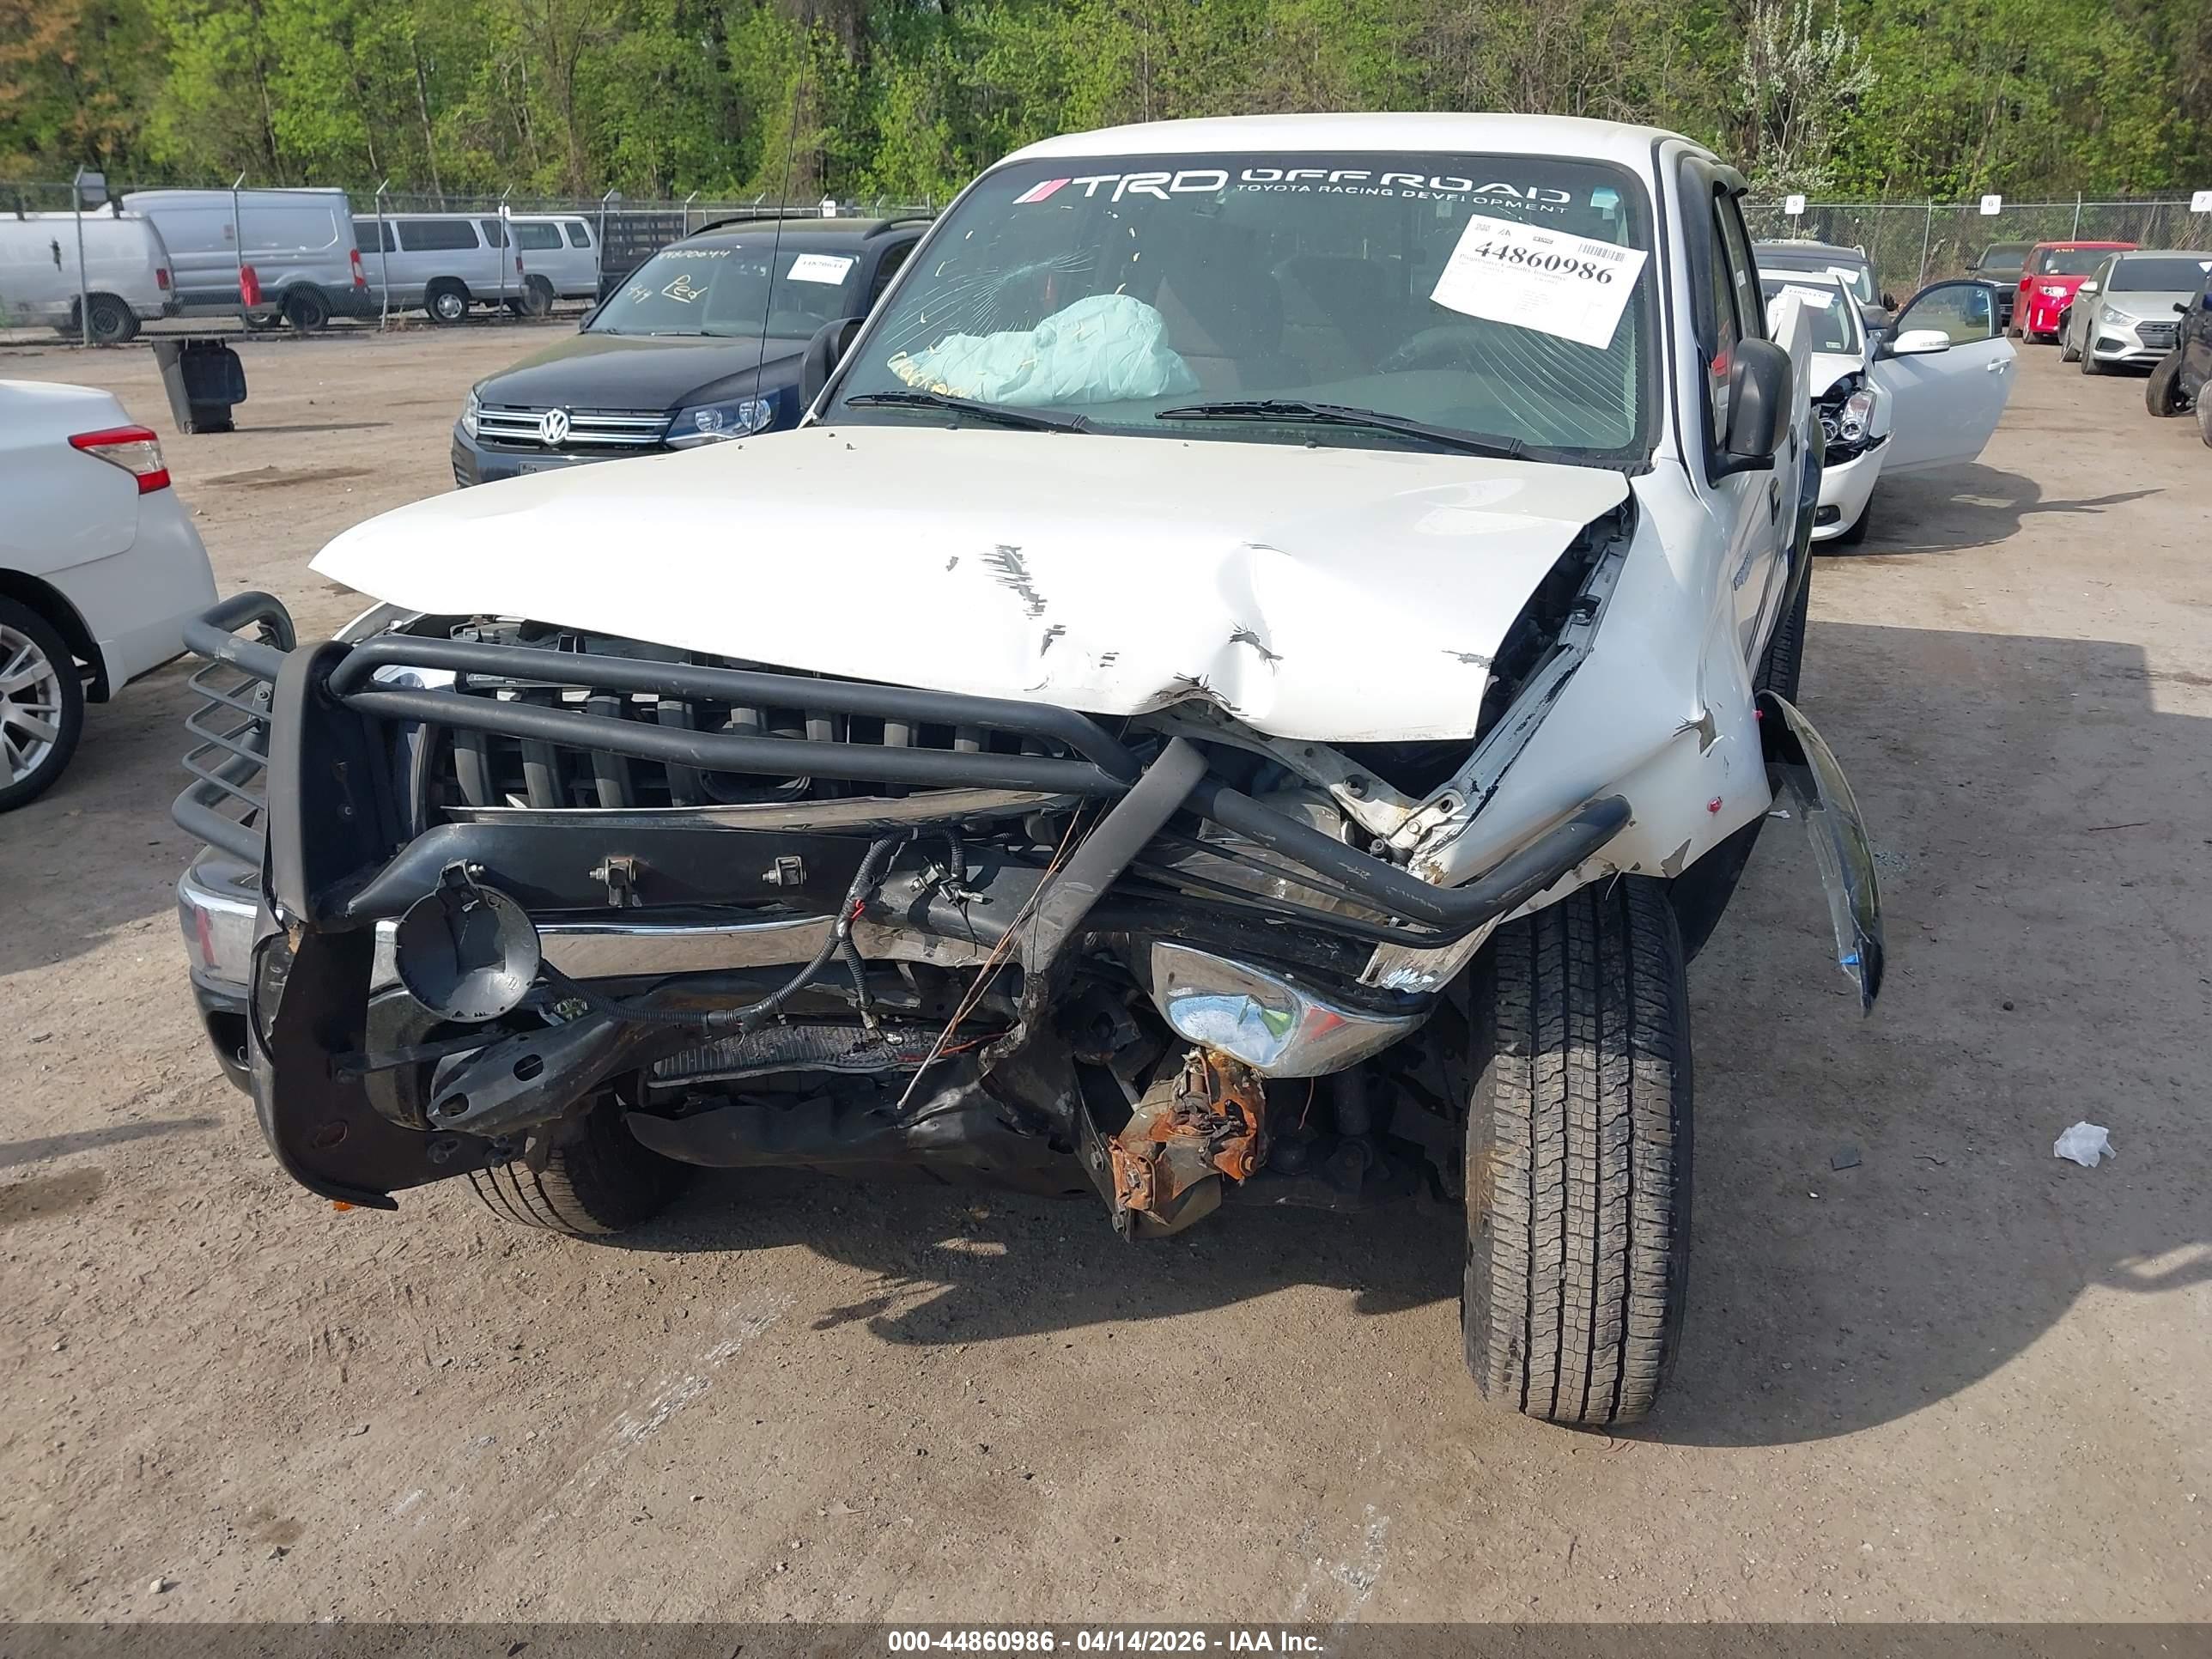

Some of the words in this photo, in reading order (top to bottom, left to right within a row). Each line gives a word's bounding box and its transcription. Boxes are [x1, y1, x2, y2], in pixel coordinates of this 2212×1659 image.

[1072, 169, 1230, 203] TRD
[1237, 184, 1311, 193] TOYOTA
[1318, 185, 1394, 198] RACING
[1240, 167, 1372, 183] OFF
[1379, 172, 1571, 204] ROAD
[1474, 240, 1616, 284] 44860986
